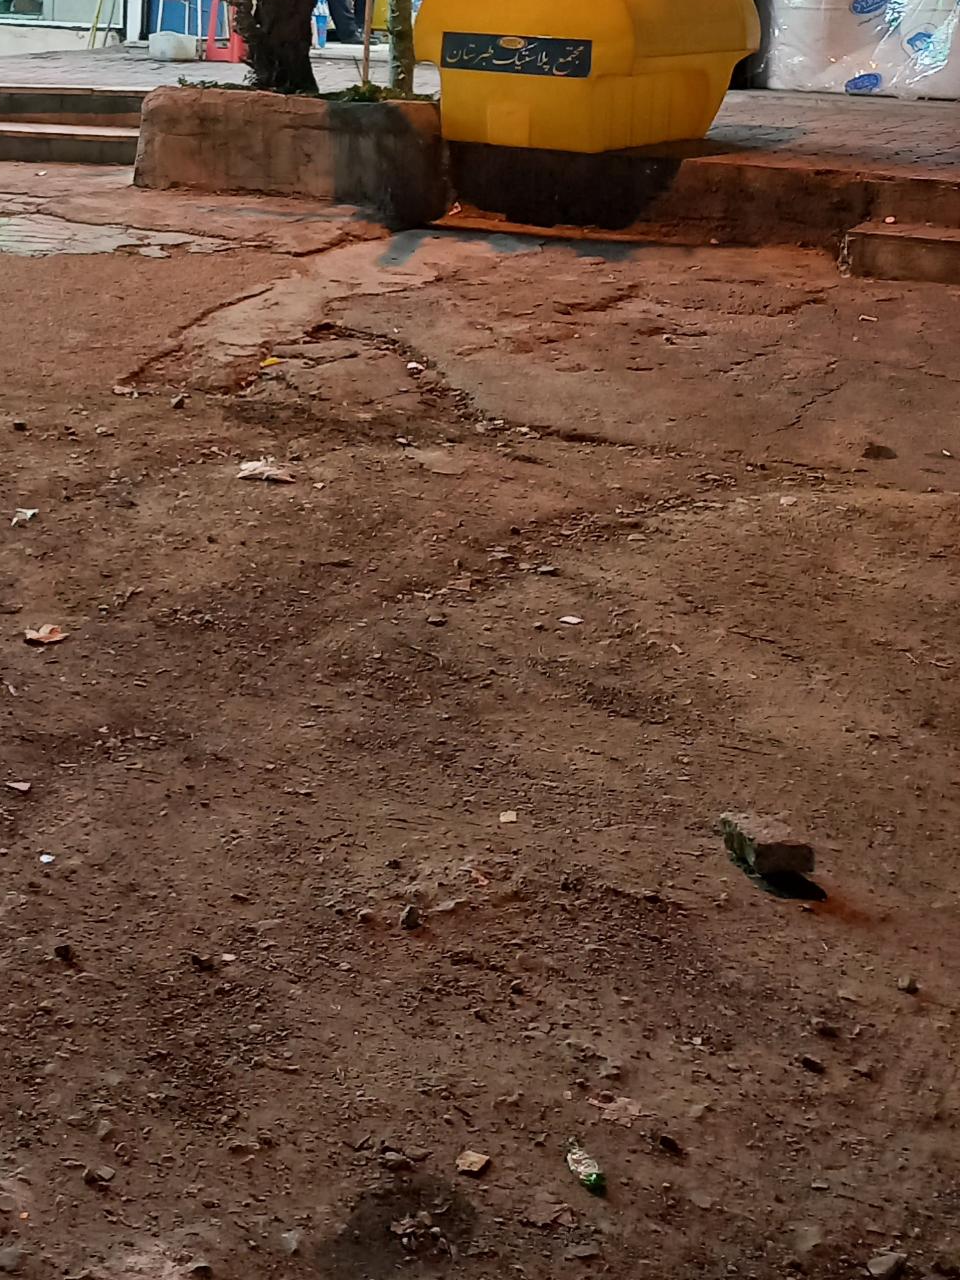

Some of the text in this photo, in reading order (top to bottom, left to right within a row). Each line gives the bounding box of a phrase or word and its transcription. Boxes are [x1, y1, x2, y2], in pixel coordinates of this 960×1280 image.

[445, 42, 585, 76] مجتمع پلاستیک طبرستان
